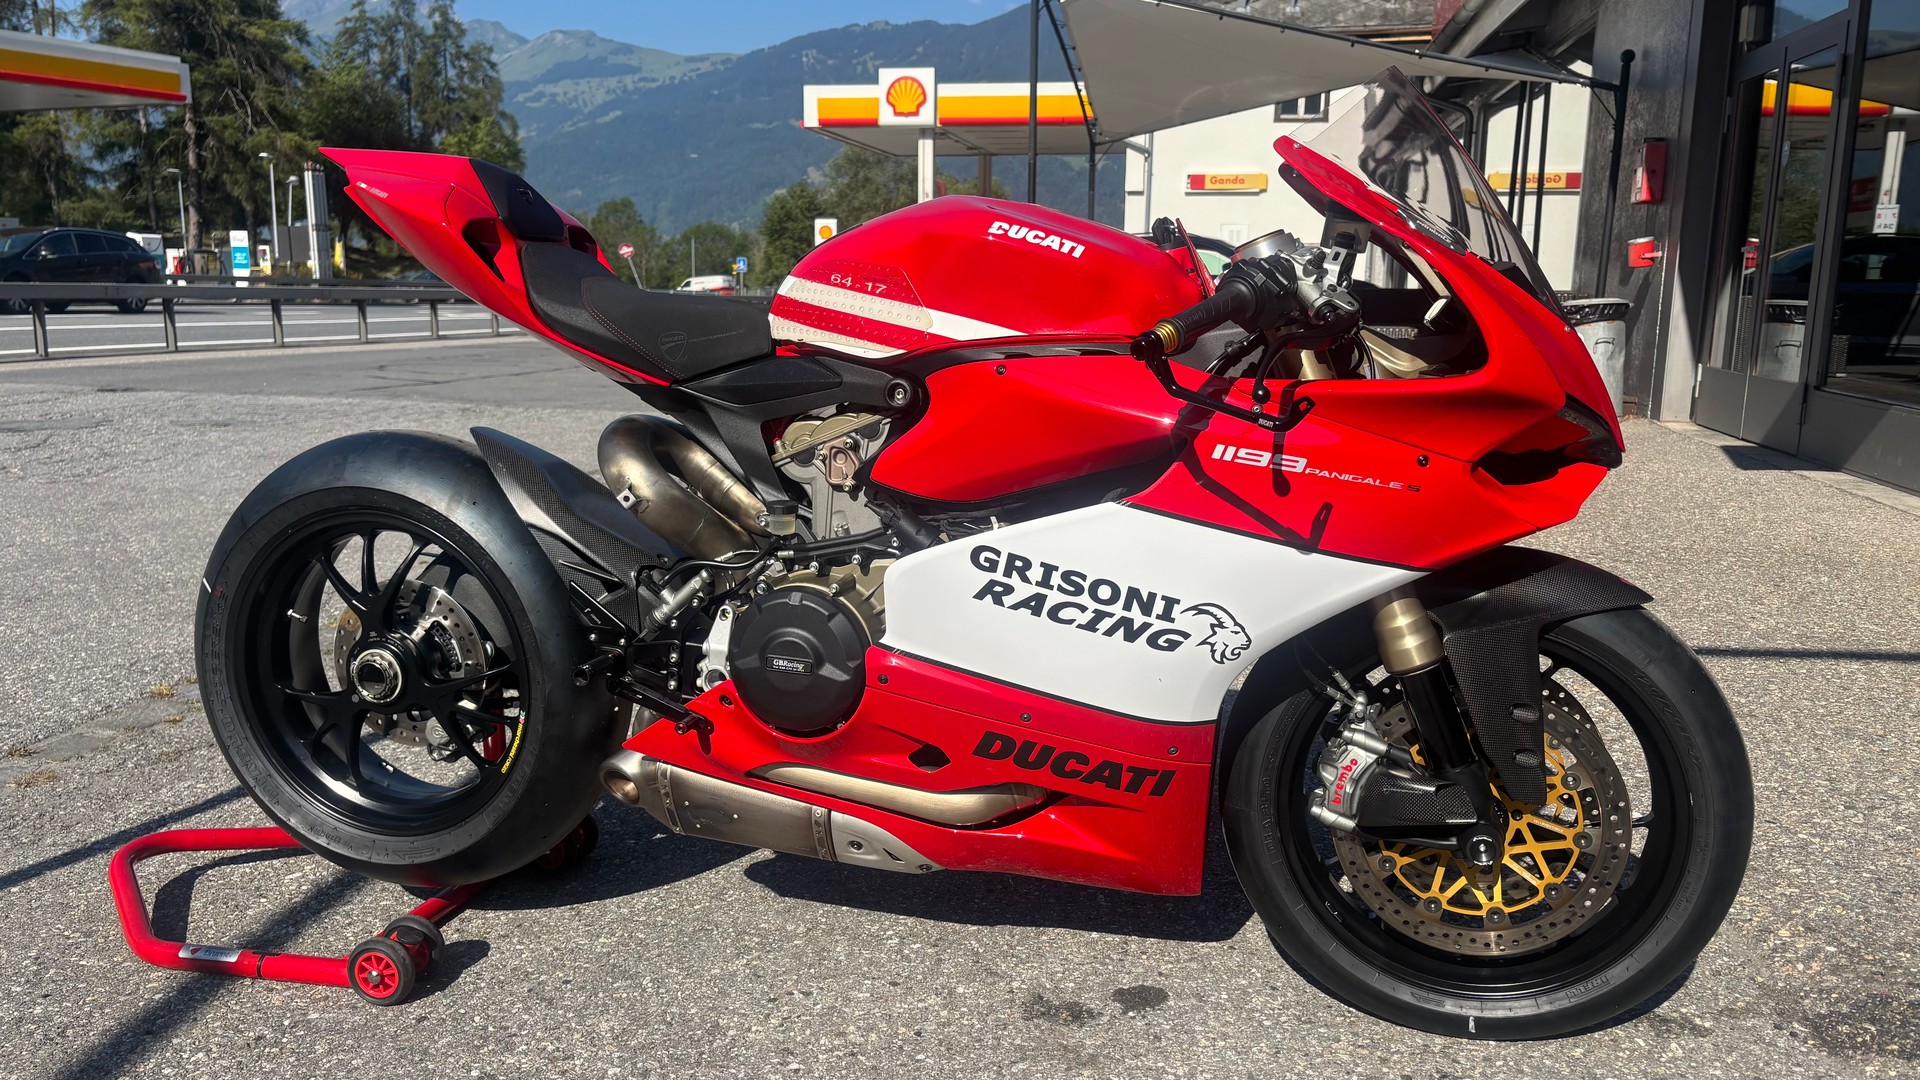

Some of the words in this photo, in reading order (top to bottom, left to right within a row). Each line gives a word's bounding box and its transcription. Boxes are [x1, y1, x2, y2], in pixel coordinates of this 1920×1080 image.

[1209, 176, 1246, 185] Ganda
[987, 220, 1086, 258] DUCATI
[1258, 418, 1274, 428] DUCATI
[1211, 443, 1308, 473] 1199
[1305, 467, 1403, 490] PANIGALE
[970, 544, 1181, 624] GRISONI
[972, 578, 1192, 652] RACING
[972, 730, 1177, 797] DUCATI
[1330, 758, 1358, 805] brembo
